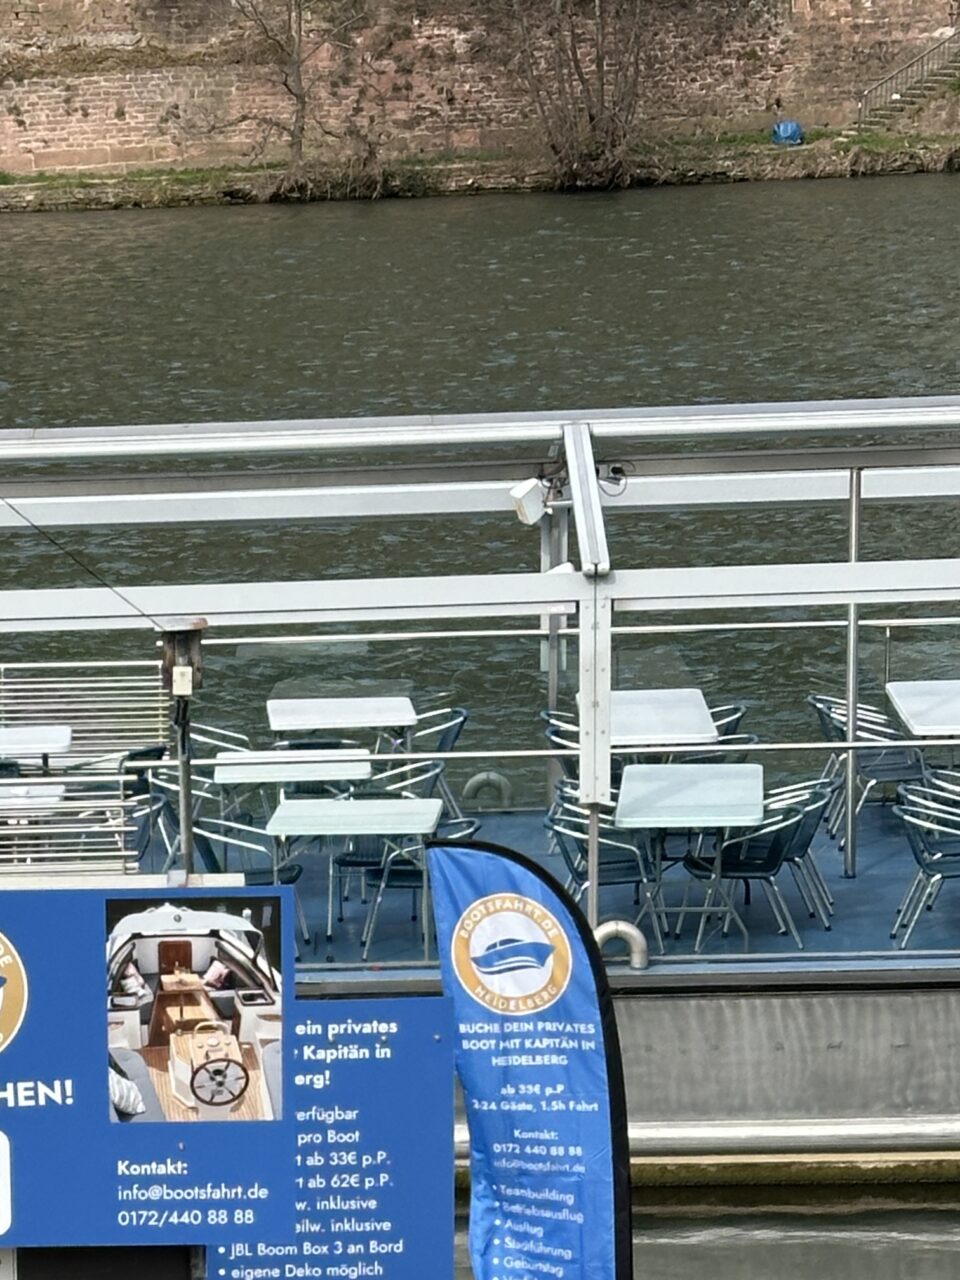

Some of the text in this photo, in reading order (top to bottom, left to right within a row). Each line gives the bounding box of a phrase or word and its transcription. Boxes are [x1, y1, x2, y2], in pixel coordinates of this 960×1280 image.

[460, 899, 558, 938] BOOTSFAHRT.DE
[475, 985, 556, 1010] HEIDELBERG
[295, 1019, 397, 1041] ein privates
[459, 1022, 595, 1034] BUCHE DEIN PRIVATES
[462, 1036, 595, 1050] BOOT MIT KAPITÄN IN
[303, 1044, 369, 1063] Kapitän
[375, 1043, 391, 1058] in
[492, 1055, 568, 1066] HEIDELBERG
[295, 1070, 330, 1089] erg!
[501, 1084, 515, 1095] ab
[518, 1084, 540, 1094] 33€
[296, 1106, 359, 1124] erfügbar
[501, 1101, 536, 1112] Gäste,
[540, 1101, 565, 1111] 1.5h
[569, 1101, 598, 1111] Fahrt
[298, 1130, 360, 1146] pro Boot
[514, 1129, 559, 1140] Kontakt:
[493, 1143, 582, 1156] 0172 440 88 88
[117, 1158, 188, 1175] Kontakt:
[306, 1151, 324, 1166] ab
[329, 1152, 357, 1165] 33€
[362, 1151, 391, 1168] p.P.
[308, 1174, 326, 1188] ab
[331, 1174, 360, 1188] 62€
[365, 1173, 393, 1190] p.P.
[118, 1183, 269, 1200] info@bootsfahrt.de
[500, 1185, 574, 1206] Teambuilding
[317, 1195, 377, 1210] inklusive
[118, 1209, 254, 1227] 0172/440 88 88
[331, 1217, 391, 1232] inklusive
[505, 1220, 543, 1238] Ausflug
[230, 1239, 404, 1259] JBL Boom Box 3 an Bord
[231, 1261, 383, 1280] eigene Deko möglich
[504, 1256, 563, 1278] Geburtstag
